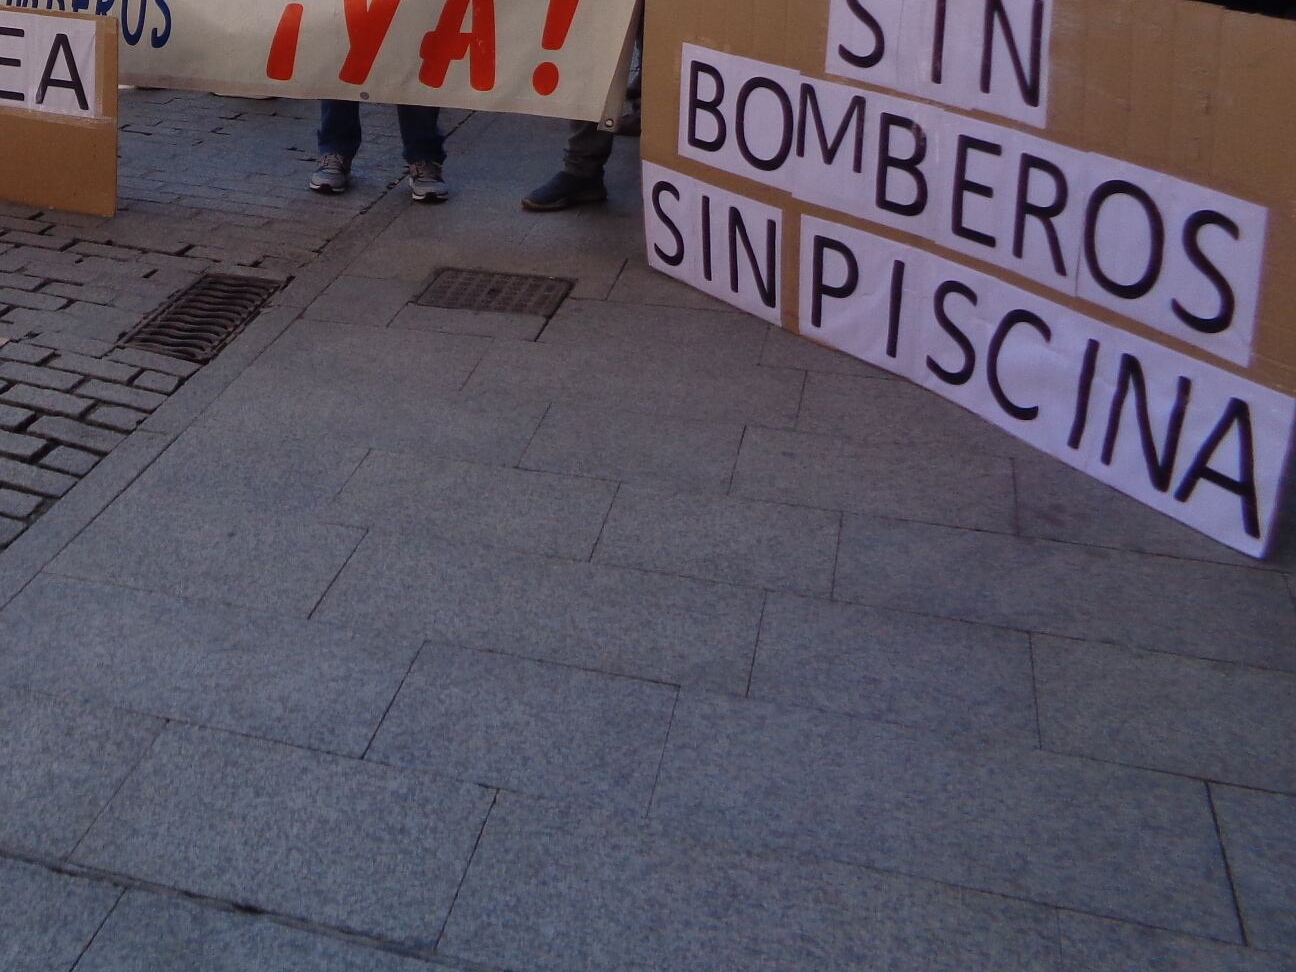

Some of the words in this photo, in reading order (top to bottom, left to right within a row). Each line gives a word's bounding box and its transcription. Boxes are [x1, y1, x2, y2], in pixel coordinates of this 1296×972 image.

[687, 60, 1240, 335] BOMBEROS
[651, 180, 778, 309] SIN
[811, 234, 1262, 541] PISCINA
